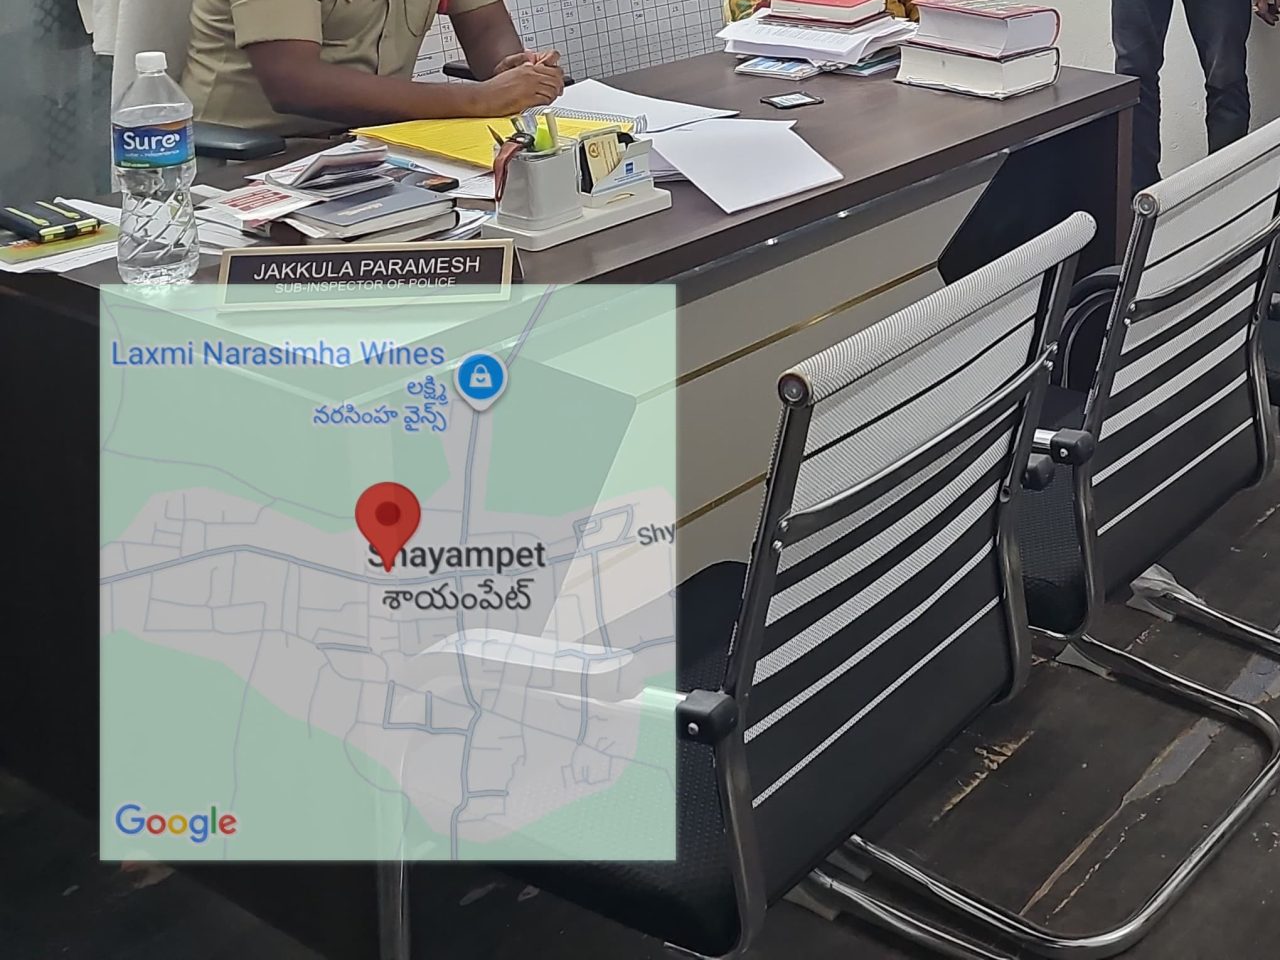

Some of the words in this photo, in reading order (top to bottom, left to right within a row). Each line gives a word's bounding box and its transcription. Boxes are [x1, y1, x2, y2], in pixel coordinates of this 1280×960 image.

[123, 131, 178, 152] Sure
[253, 256, 354, 281] JAKKULA
[359, 253, 481, 277] PARAMESH
[274, 278, 382, 295] SUB-INSPECTOR
[386, 278, 406, 293] OF
[409, 276, 457, 291] POLICE
